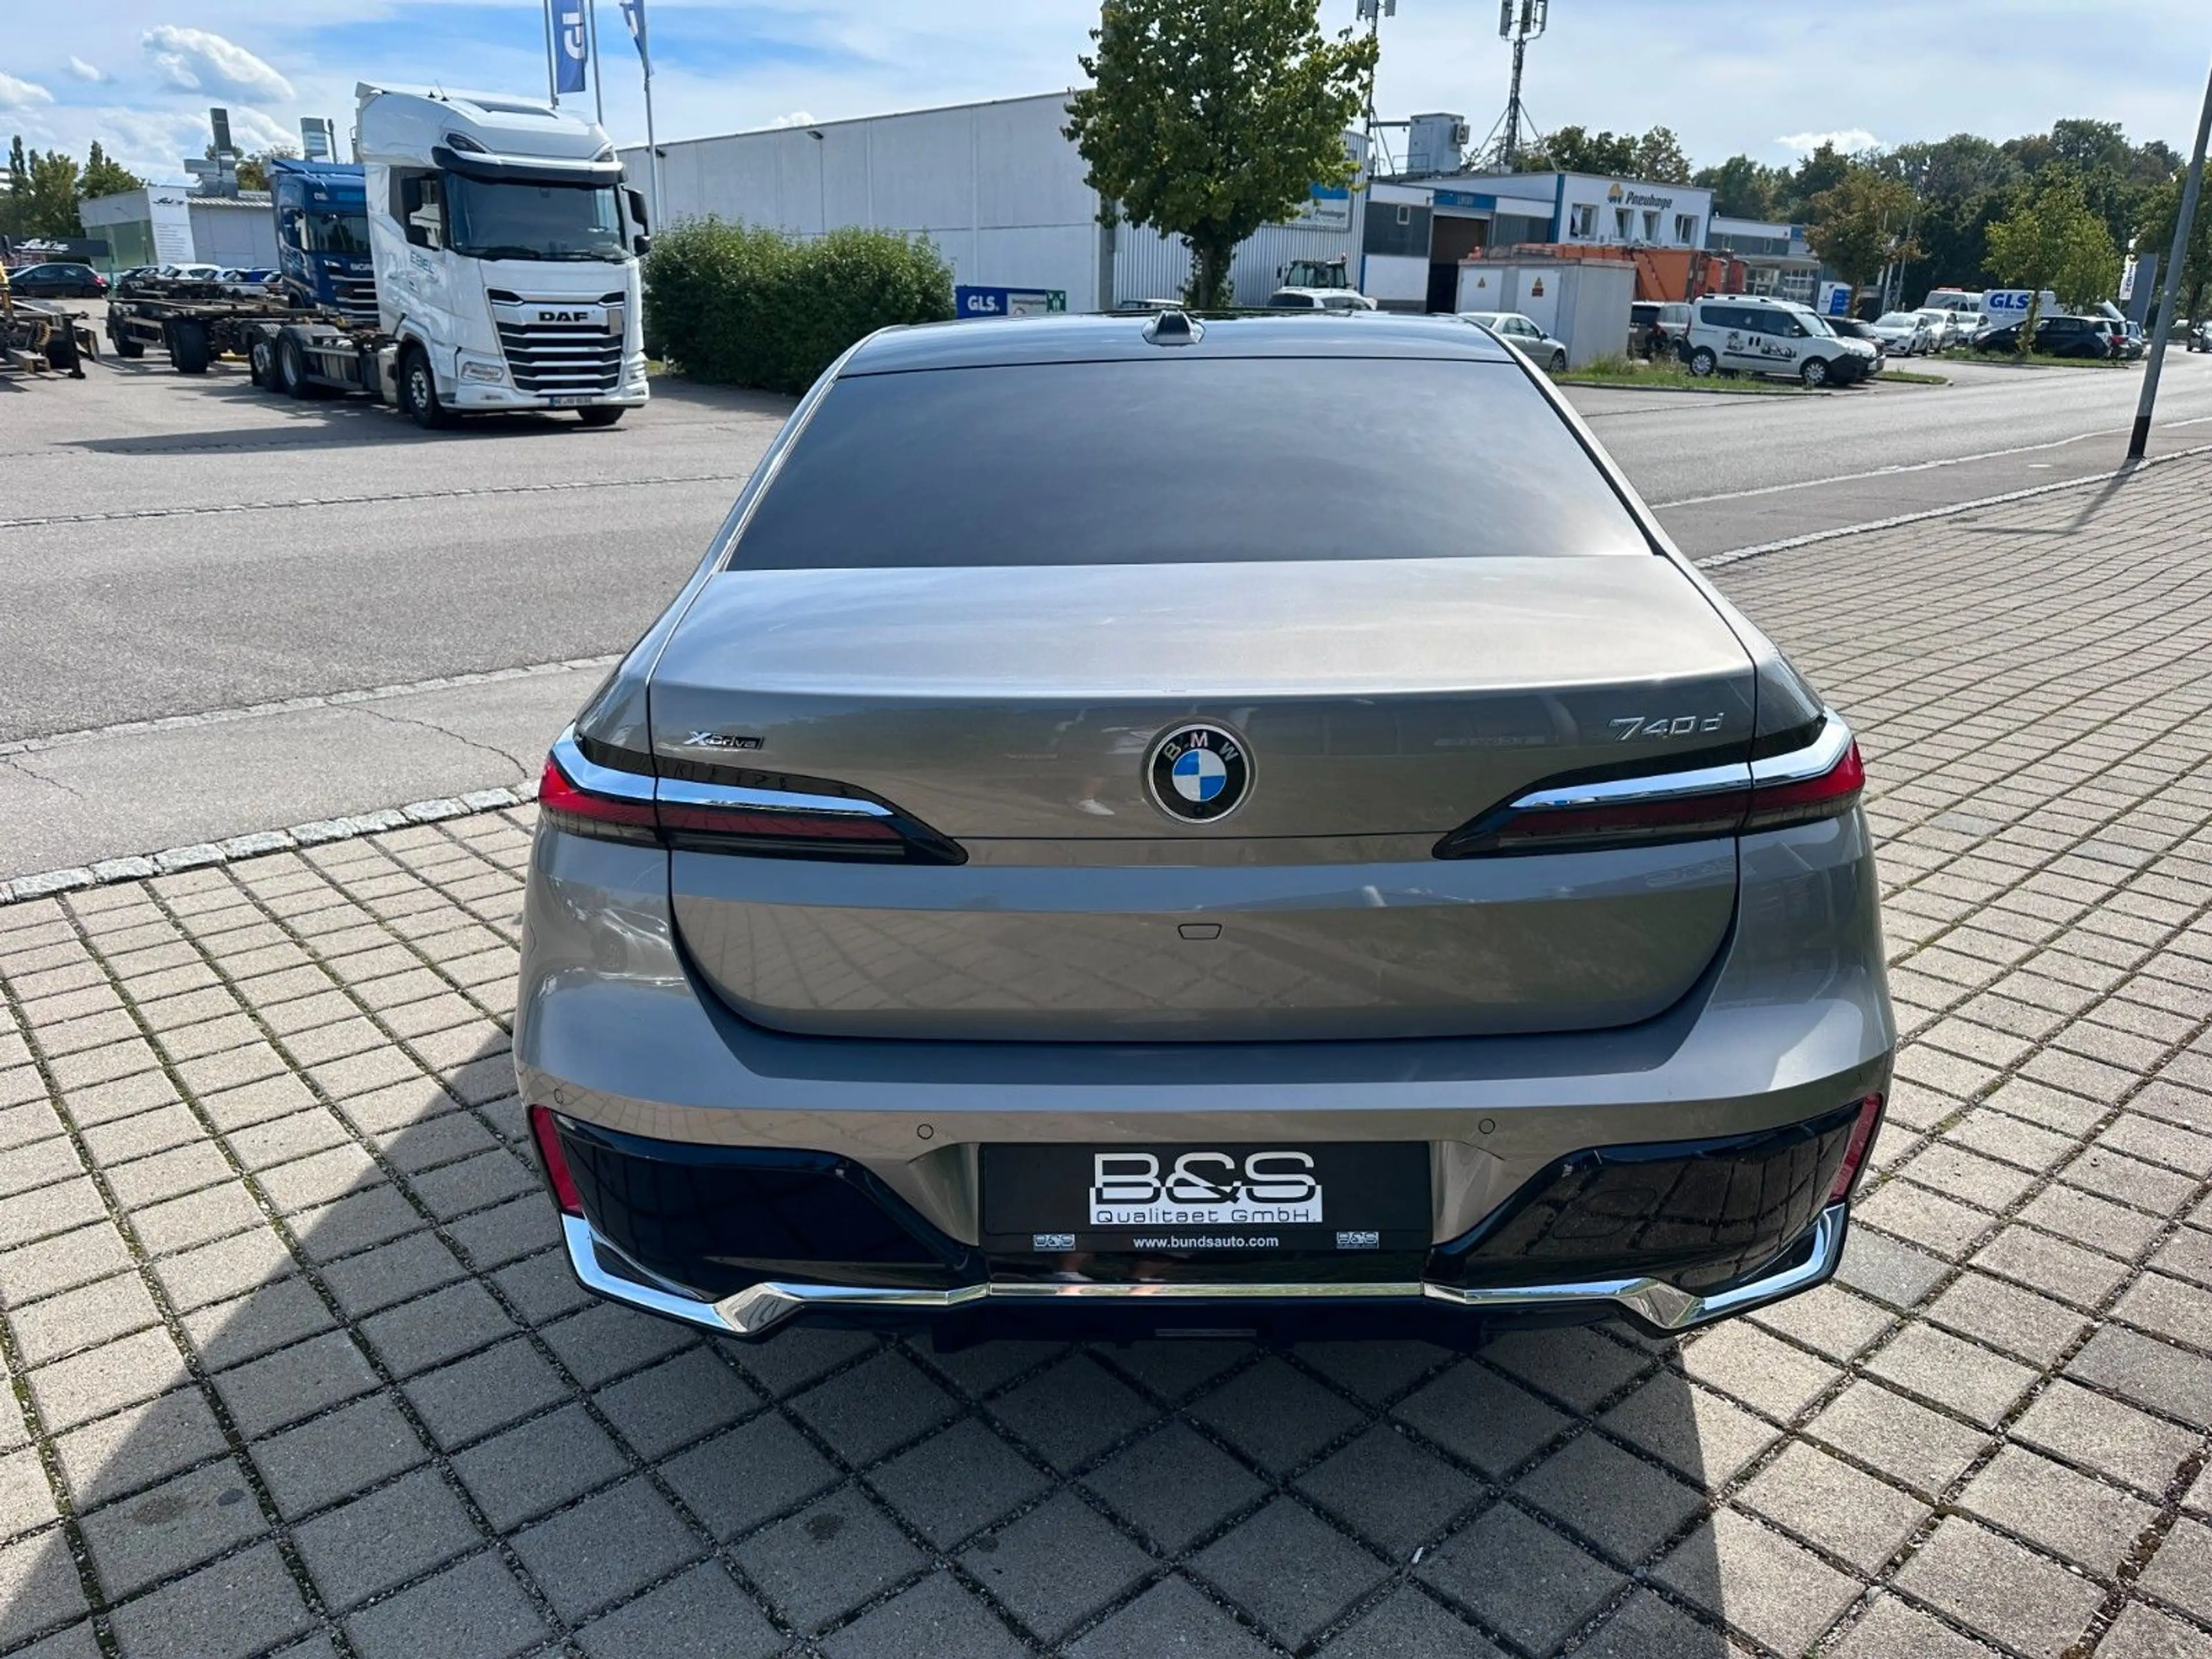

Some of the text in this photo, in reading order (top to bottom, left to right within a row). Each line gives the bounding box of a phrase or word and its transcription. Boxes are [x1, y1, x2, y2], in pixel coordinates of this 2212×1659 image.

[562, 0, 585, 59] GL
[1990, 293, 2029, 309] GLS
[539, 312, 588, 321] DAF
[1163, 731, 1238, 762] BMW
[1094, 1152, 1316, 1205] B&S
[1097, 1207, 1219, 1223] Qualitaet
[1133, 1235, 1279, 1248] www.bundsauto.com
